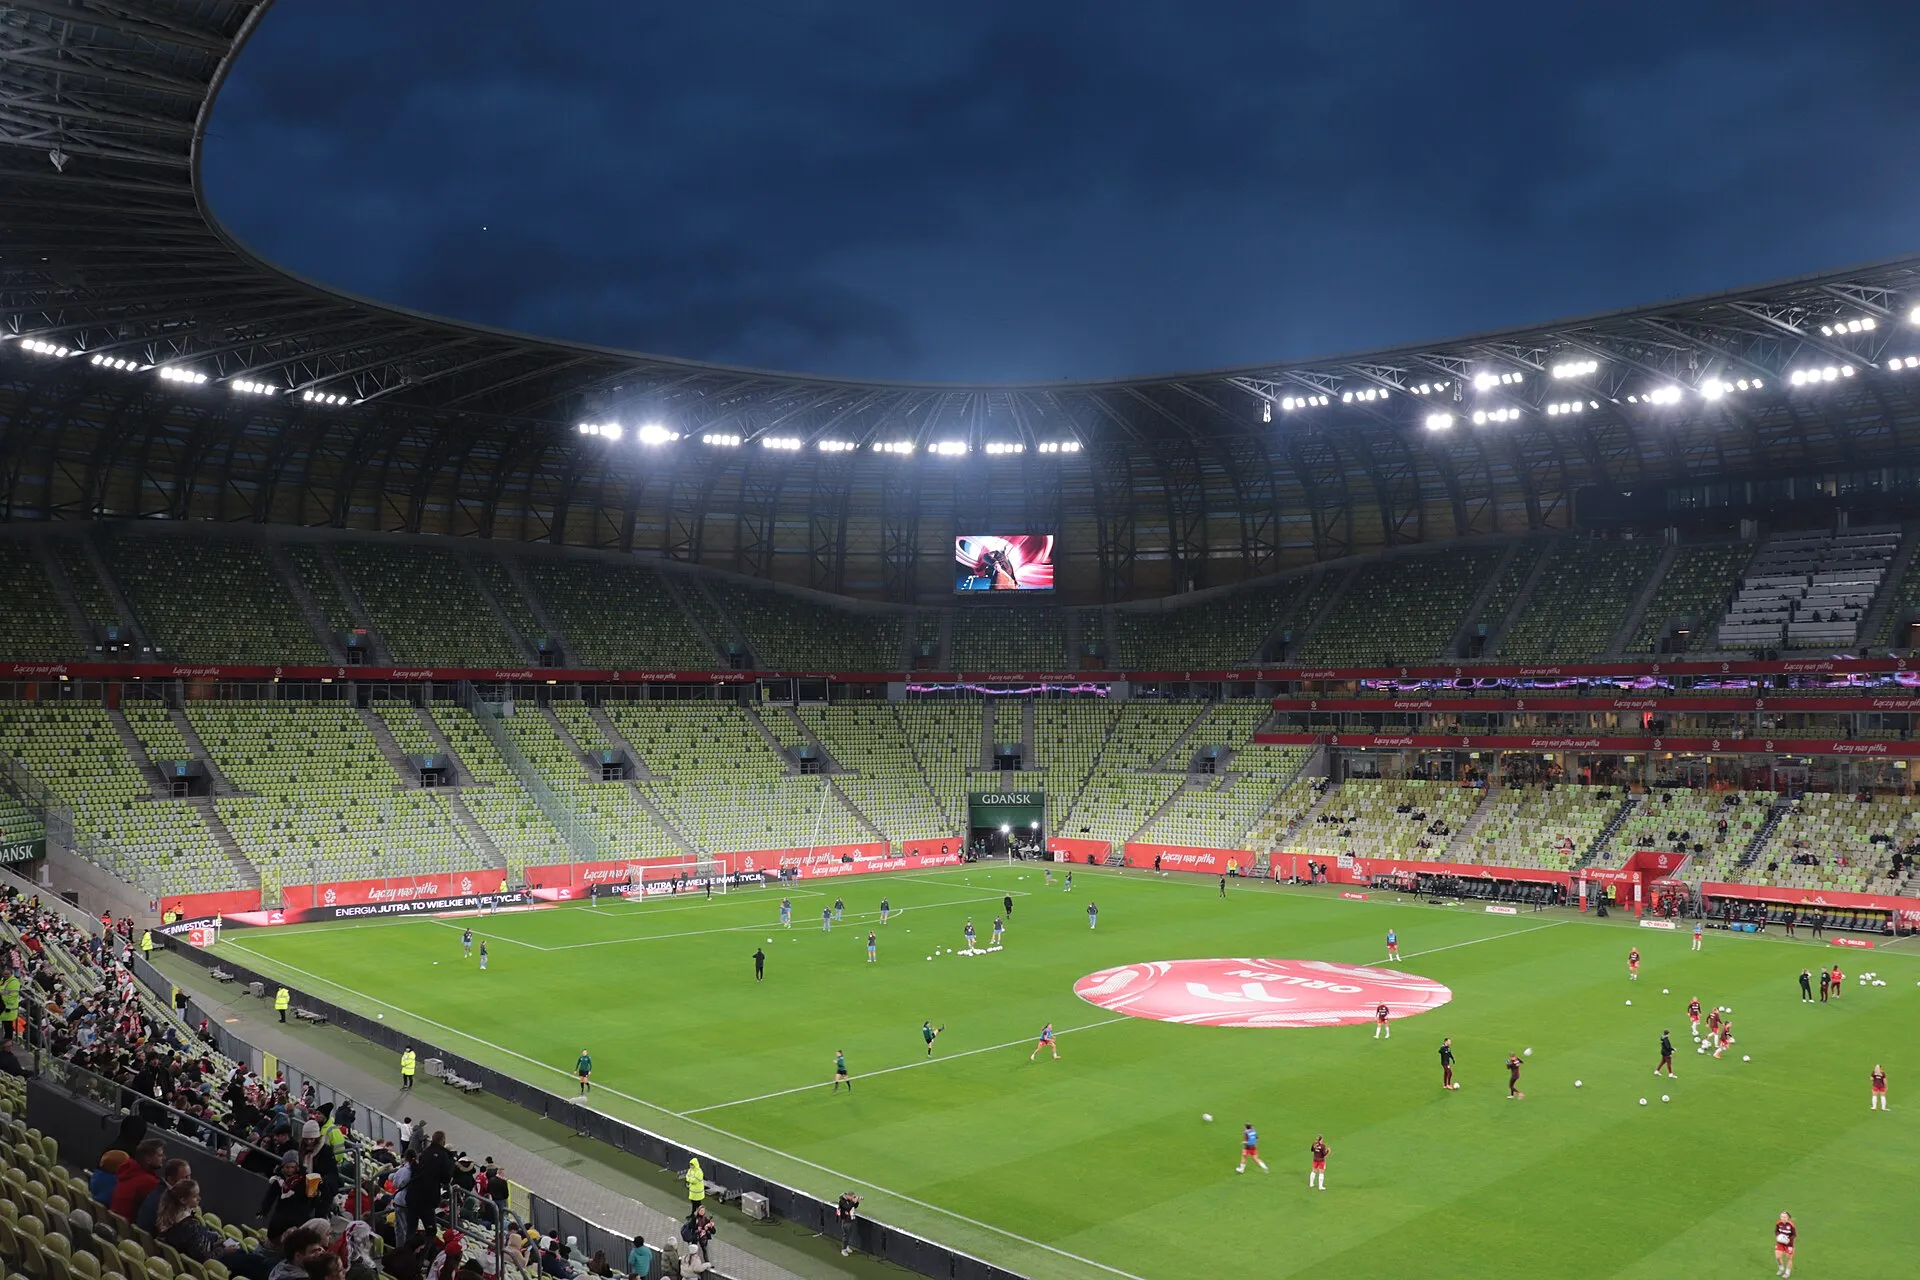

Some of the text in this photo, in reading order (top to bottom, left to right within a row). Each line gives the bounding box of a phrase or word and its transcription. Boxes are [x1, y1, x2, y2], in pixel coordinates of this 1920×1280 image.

[982, 792, 1030, 804] GDAŃSK
[0, 844, 34, 862] AŃSK
[921, 856, 936, 865] Łączy
[944, 853, 958, 864] piłka
[1162, 851, 1216, 866] Łączy nas piłka
[812, 865, 829, 876] Łączy
[838, 863, 852, 875] piłka
[868, 860, 884, 870] Łączy
[892, 858, 906, 869] piłka
[584, 868, 608, 883] Łączy
[646, 882, 671, 890] JUTRA
[685, 876, 715, 886] WIELKE
[716, 874, 761, 884] INWETYCJ
[368, 887, 396, 902] Łączy
[398, 888, 414, 899] nas
[336, 905, 378, 917] ENERGIA
[378, 903, 410, 913] JUTRA
[411, 901, 425, 910] TO
[426, 897, 463, 908] WIELKIE
[1904, 910, 1920, 921] na
[170, 919, 222, 934] INWESTYCJE
[1224, 970, 1363, 993] ORLEN
